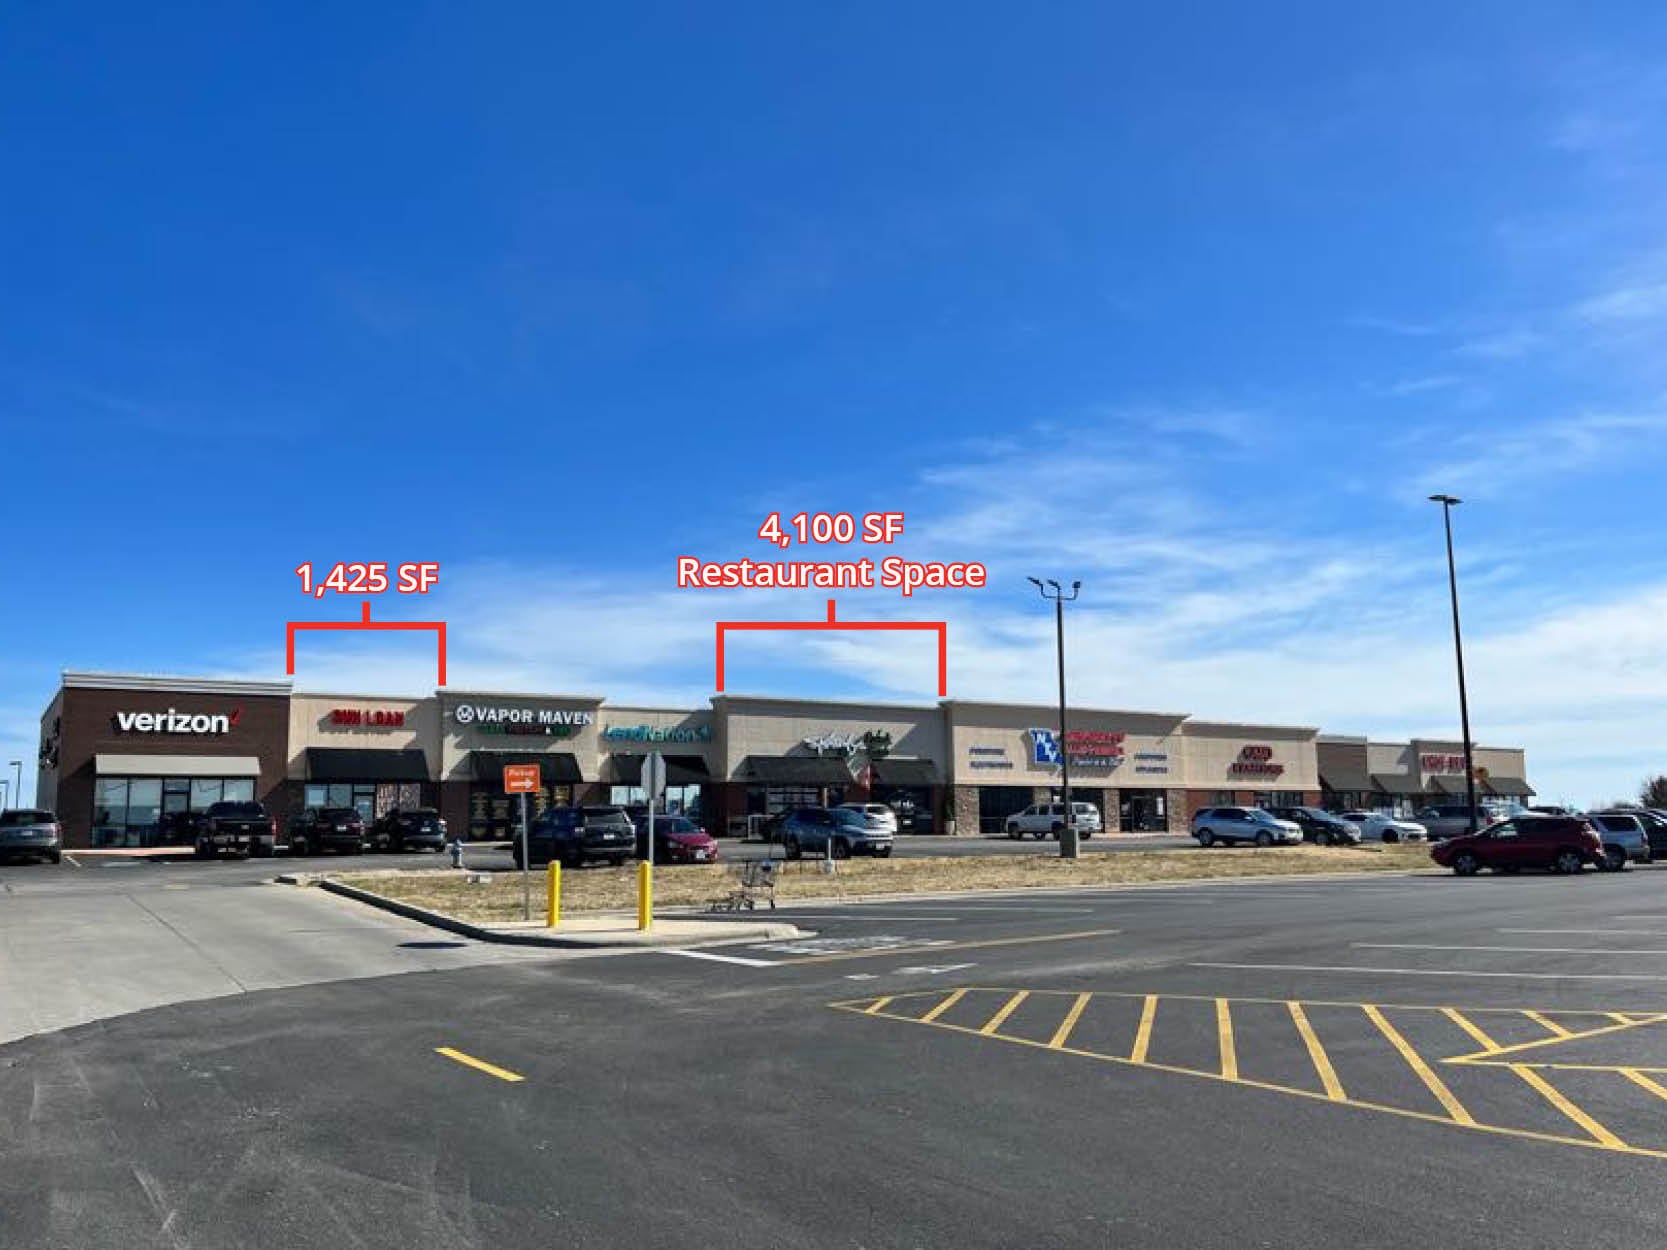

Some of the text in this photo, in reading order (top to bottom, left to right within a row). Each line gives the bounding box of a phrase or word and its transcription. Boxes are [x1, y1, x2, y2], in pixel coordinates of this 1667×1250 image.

[116, 707, 229, 734] verizon
[475, 705, 593, 727] VAPOR MAVEN
